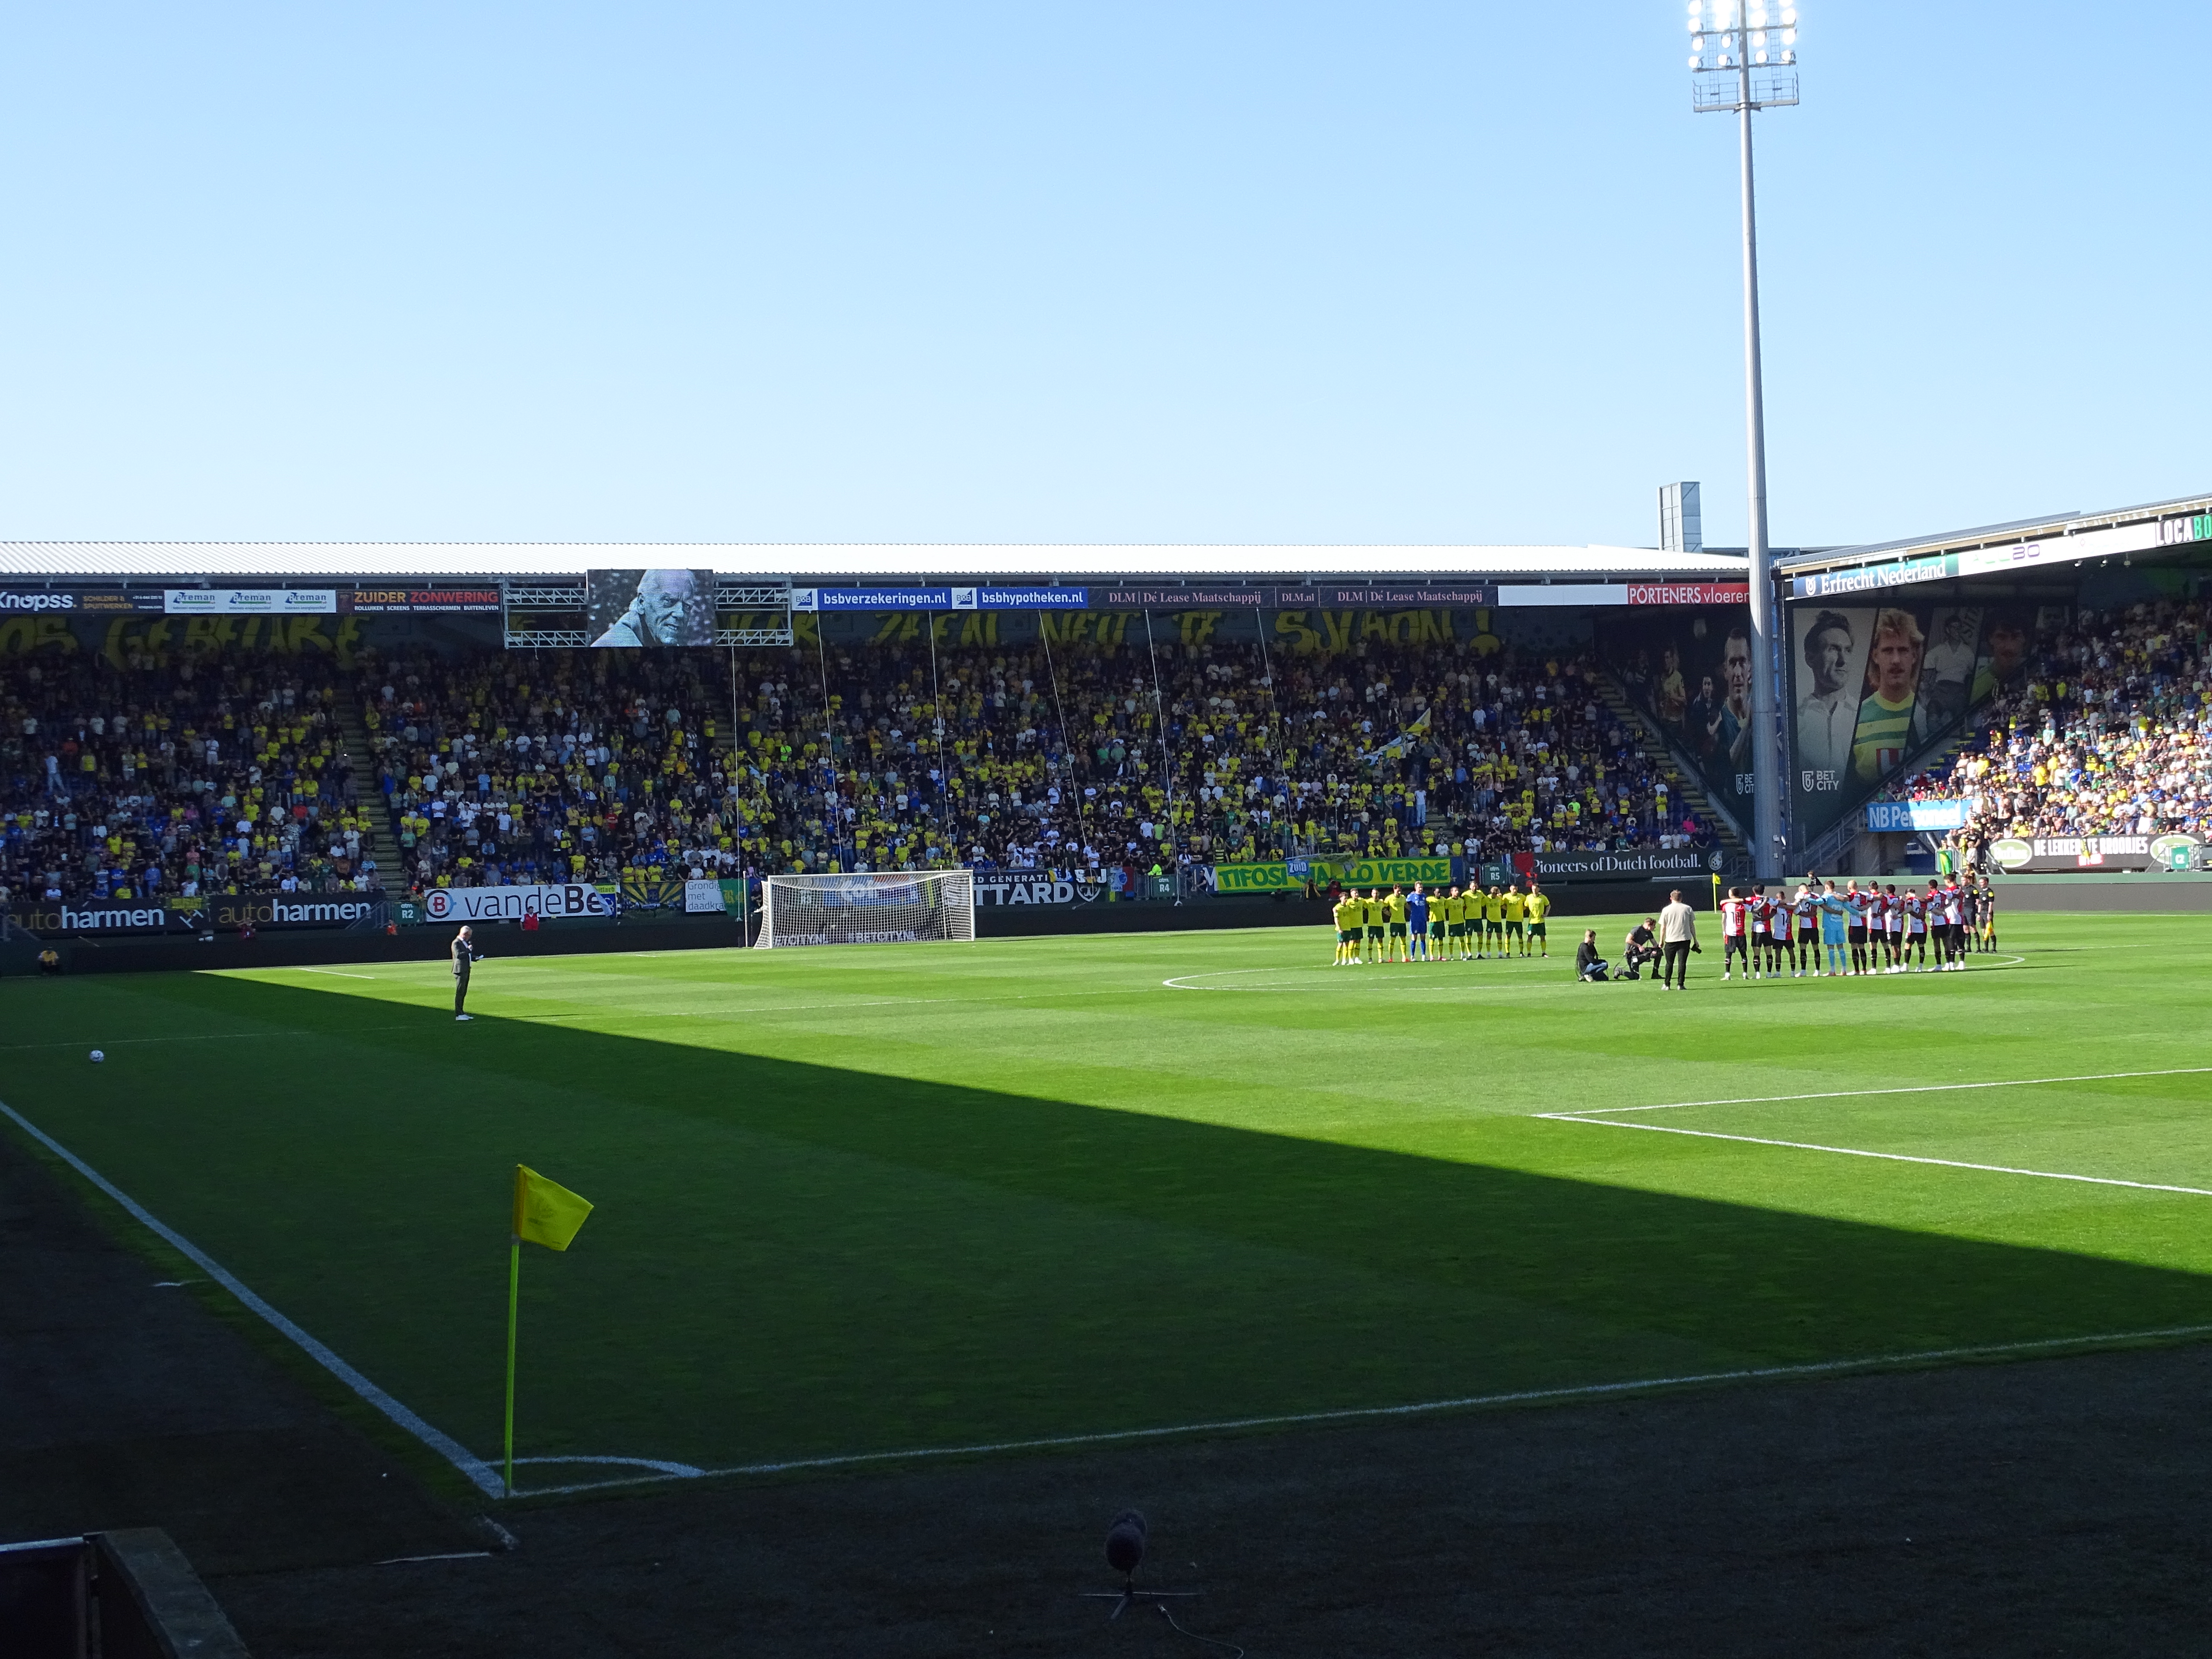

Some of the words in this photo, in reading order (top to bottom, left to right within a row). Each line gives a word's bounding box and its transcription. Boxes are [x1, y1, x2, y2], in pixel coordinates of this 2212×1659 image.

[2156, 515, 2212, 545] LOCABO
[1821, 570, 1874, 594] Erfrecht
[1877, 556, 1947, 586] Nederland
[355, 592, 405, 602] ZUIDER
[410, 591, 498, 603] ZONWERING
[824, 593, 946, 606] bsbverzekeringen.nl
[982, 592, 1083, 605] bsbhypotheken.nl
[1109, 592, 1135, 602] DLM
[1144, 591, 1157, 602] Dé
[1160, 592, 1189, 602] Lease
[1193, 591, 1261, 604] Maatschappij
[1282, 593, 1314, 602] DLM.nl
[1338, 592, 1363, 601] DLM
[1371, 591, 1383, 601] Dé
[1386, 591, 1414, 601] Lease
[1417, 591, 1482, 603] Maatschappij
[1629, 585, 1701, 604] PÖRTENERS
[1817, 770, 1835, 780] BET
[1816, 780, 1839, 791] CITY
[1869, 806, 1889, 828] NB
[2034, 839, 2046, 856] DE
[2048, 838, 2097, 856] LEKKERTE
[2100, 837, 2148, 854] BROODJES
[1289, 861, 1307, 873] ZUID
[1534, 859, 1588, 873] Pioneers
[1590, 857, 1605, 871] of
[1607, 855, 1646, 870] Dutch
[1650, 853, 1701, 869] football.
[990, 875, 1048, 883] GENERATI
[1218, 867, 1288, 888] TIFOSI
[1380, 862, 1449, 882] VERDE
[1159, 884, 1170, 892] R4
[688, 892, 705, 900] met
[219, 898, 371, 924] autoharmen
[402, 910, 413, 919] R2
